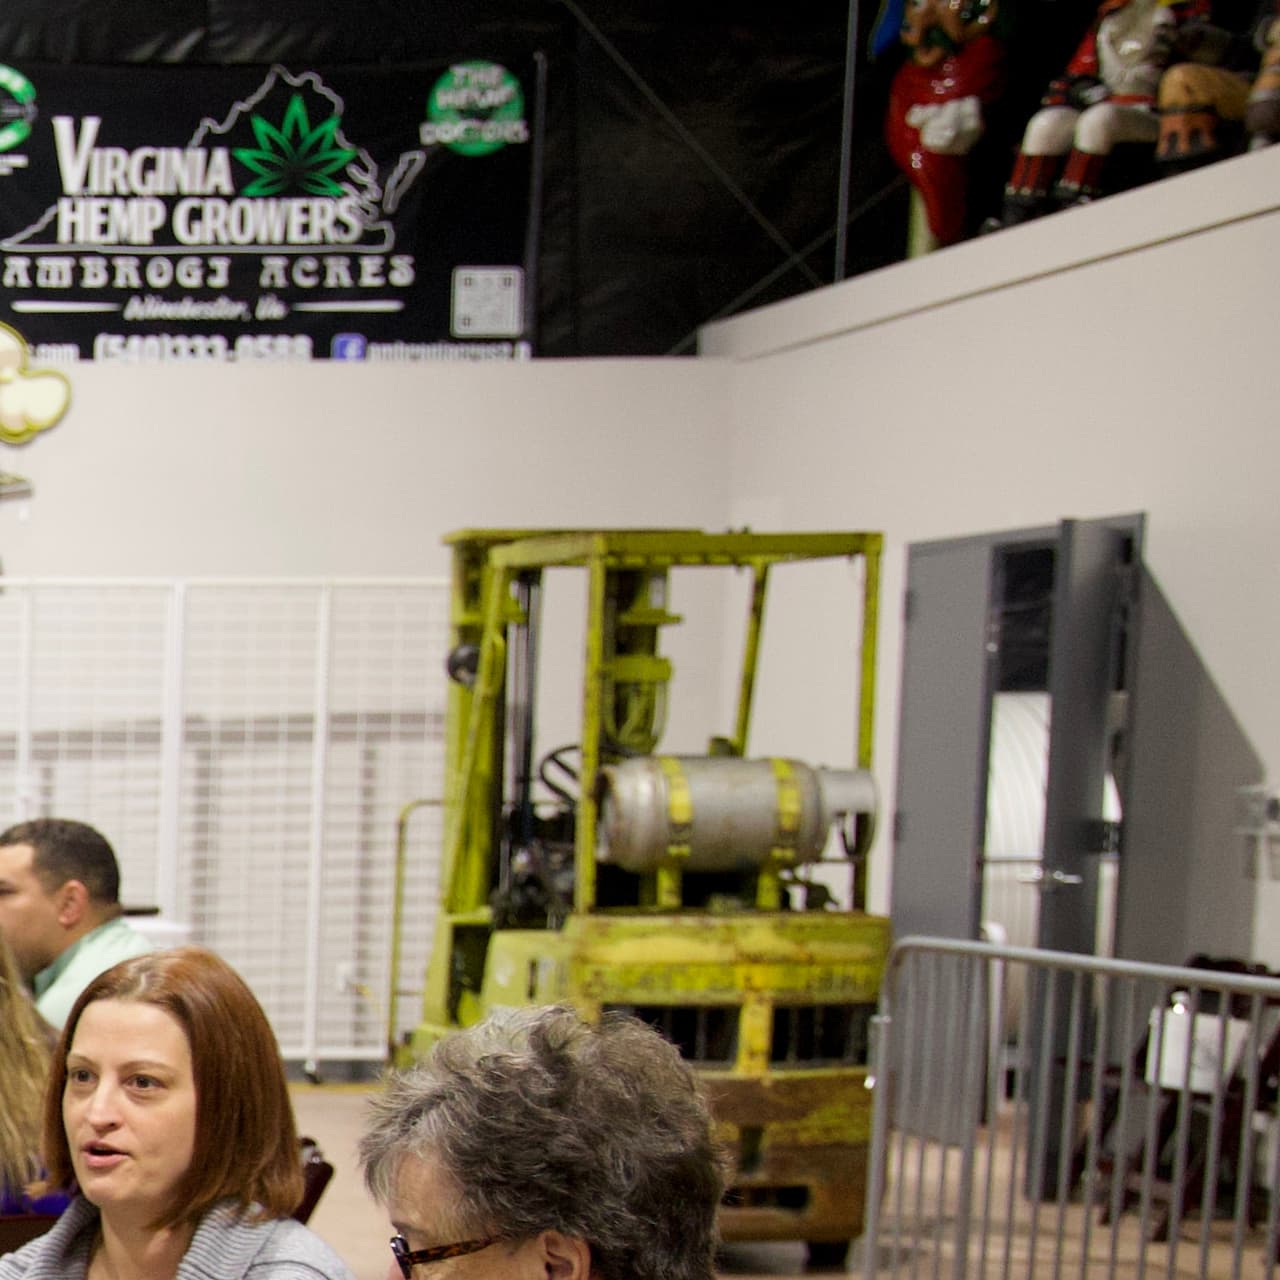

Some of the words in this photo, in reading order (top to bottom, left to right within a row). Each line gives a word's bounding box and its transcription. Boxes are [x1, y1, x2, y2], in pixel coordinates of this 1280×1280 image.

[57, 198, 166, 245] HEMP
[172, 198, 363, 245] GROWERS
[2, 256, 231, 288] AMBROGI
[259, 256, 416, 287] ACRES
